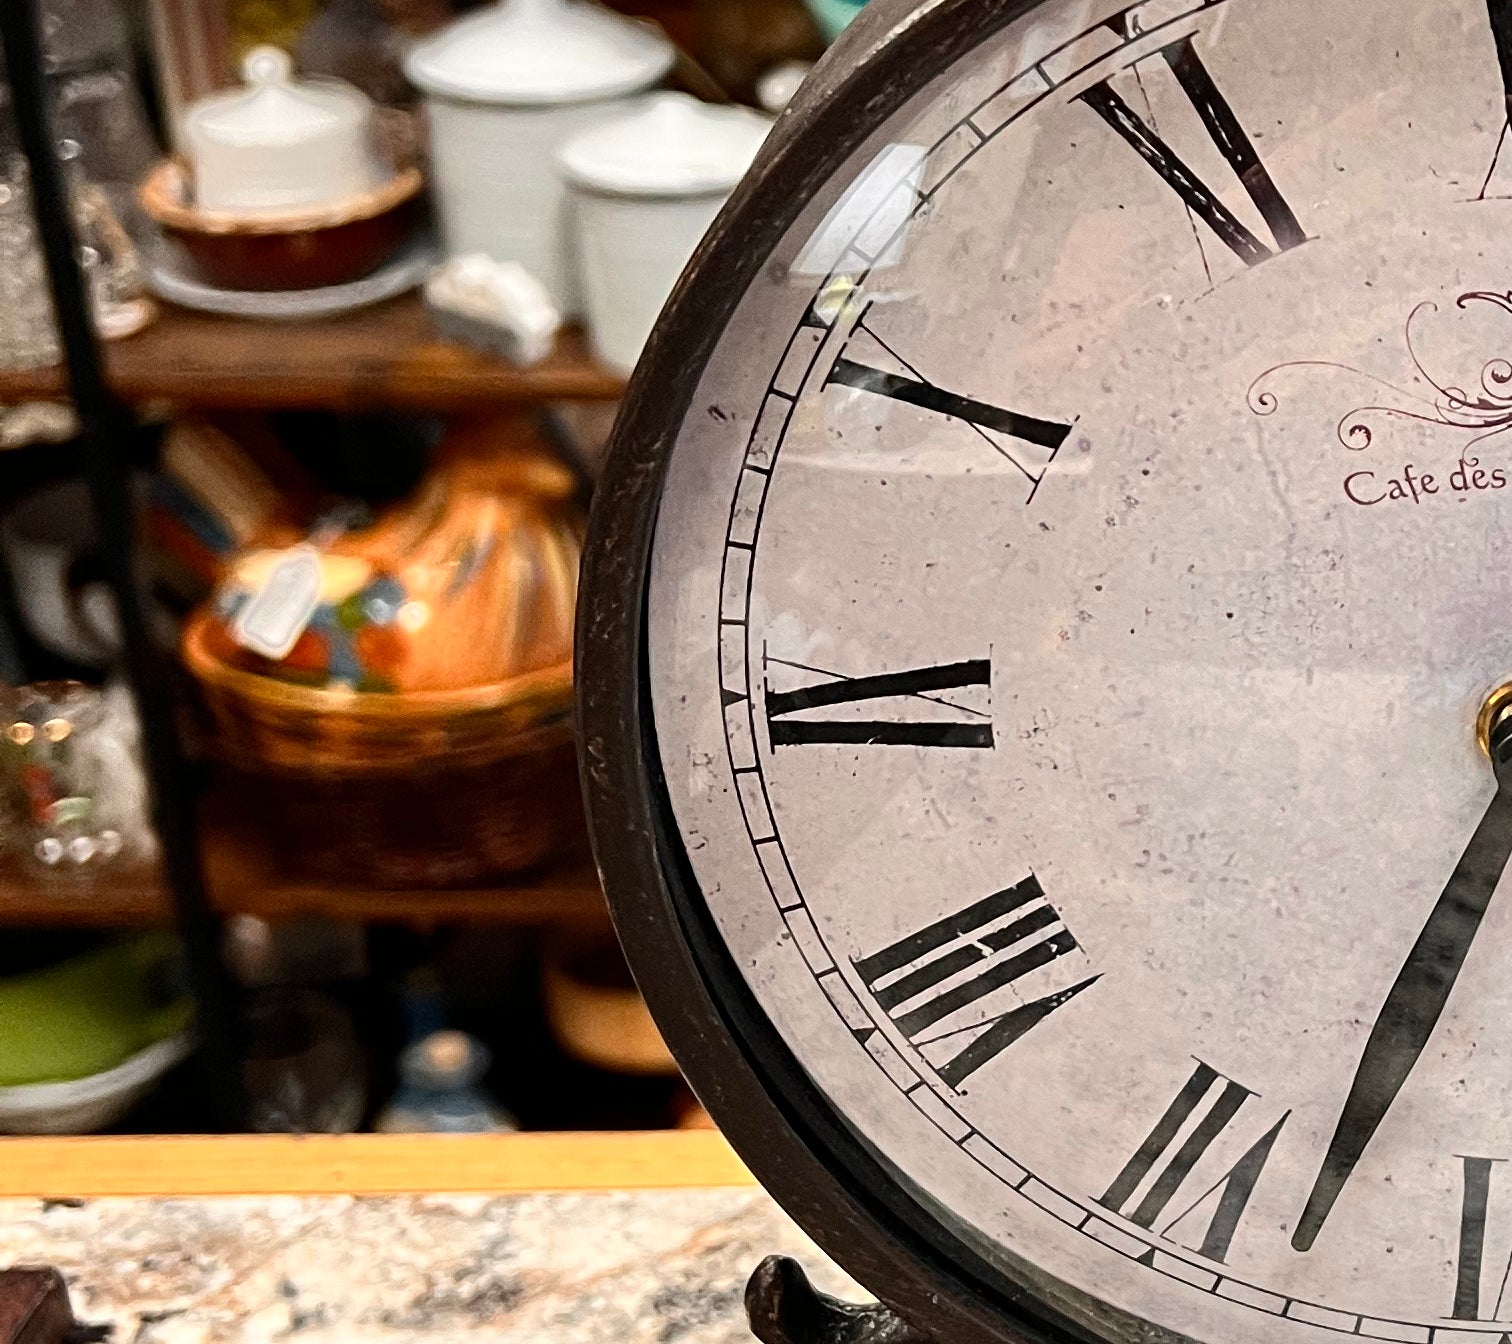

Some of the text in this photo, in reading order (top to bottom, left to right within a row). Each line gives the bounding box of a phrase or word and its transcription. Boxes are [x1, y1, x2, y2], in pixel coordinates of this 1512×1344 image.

[1067, 30, 1320, 305] XI
[820, 299, 1081, 505] X
[1343, 462, 1440, 506] Cafe
[1450, 456, 1507, 492] des
